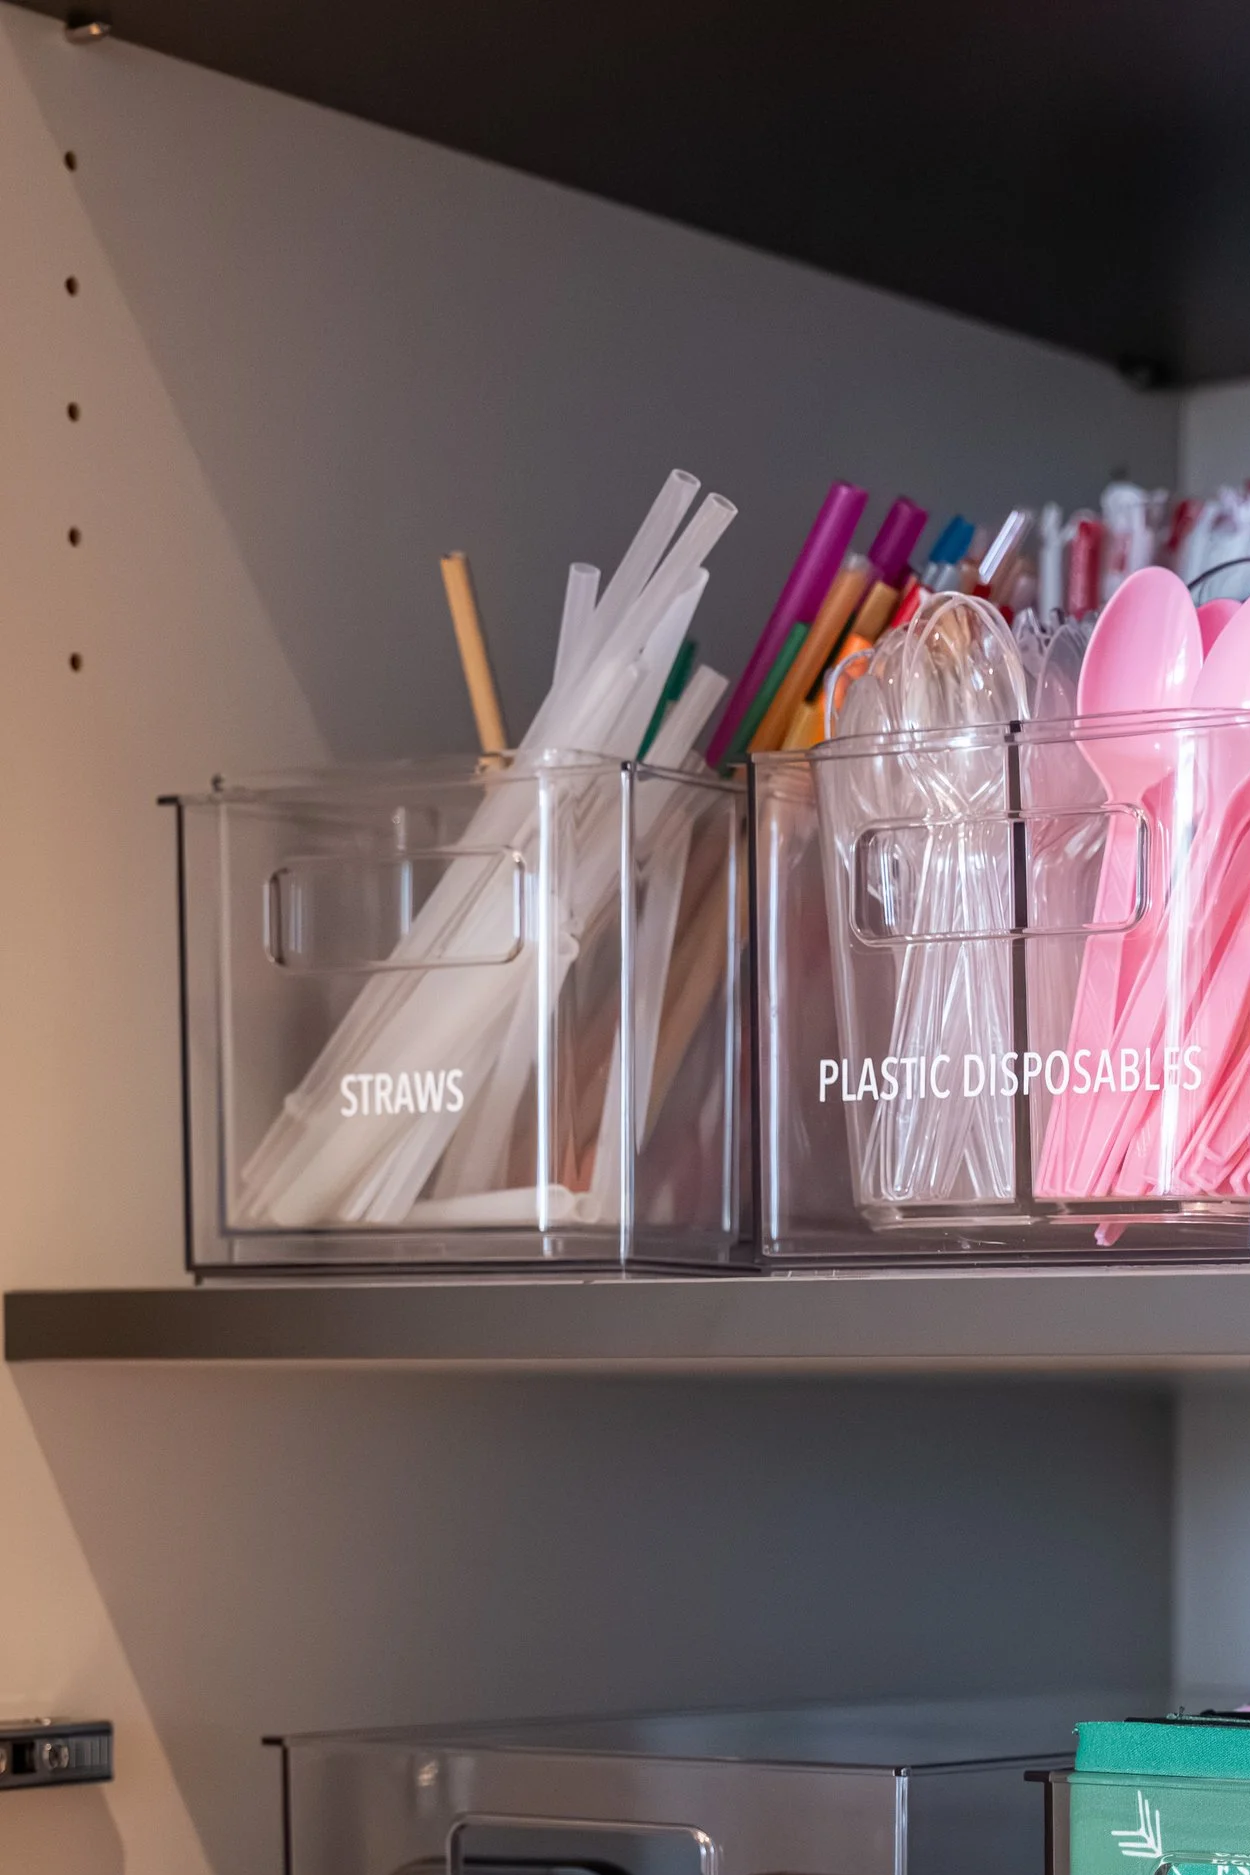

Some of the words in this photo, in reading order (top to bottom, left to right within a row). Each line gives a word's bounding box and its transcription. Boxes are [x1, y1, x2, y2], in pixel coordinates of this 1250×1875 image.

[340, 1068, 464, 1117] STRAWS
[819, 1054, 951, 1102] PLASTIC
[963, 1045, 1202, 1098] DISPOSABLES
